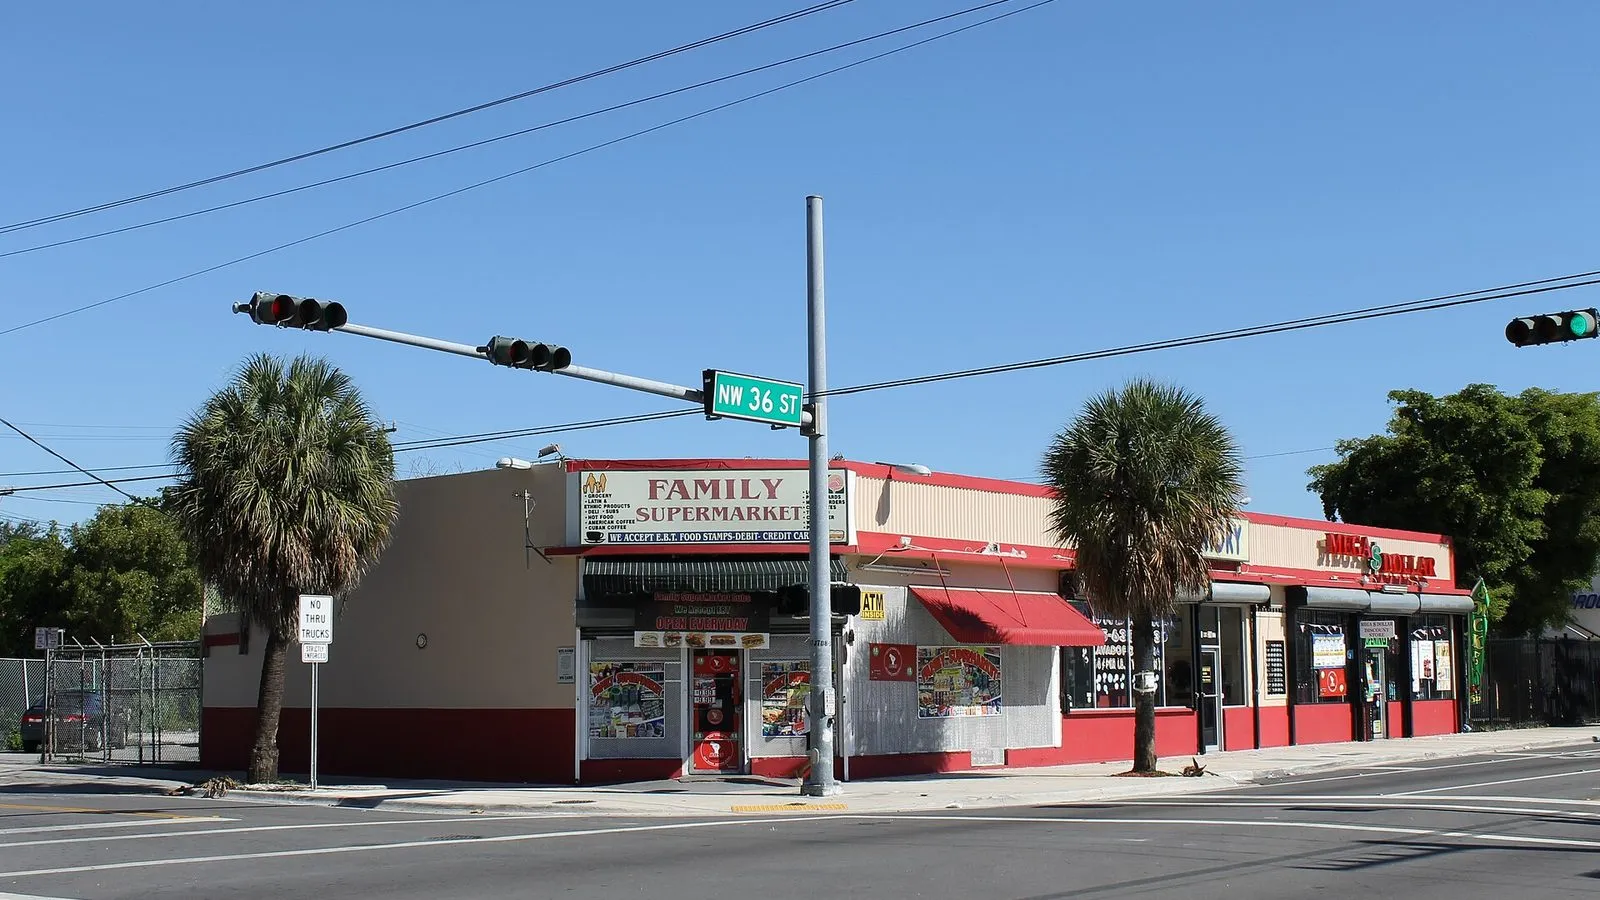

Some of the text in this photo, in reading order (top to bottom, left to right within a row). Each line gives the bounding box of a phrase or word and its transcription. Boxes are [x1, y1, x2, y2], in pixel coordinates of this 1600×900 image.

[718, 384, 798, 415] NW 36 ST
[648, 478, 783, 500] FAMILY
[635, 505, 802, 523] SUPERMARKET
[609, 533, 623, 542] WE
[624, 533, 655, 542] ACCEPT
[656, 533, 678, 542] E.B.T.
[679, 533, 702, 541] FOOD
[763, 531, 792, 540] CREDIT
[793, 531, 810, 540] CAR
[1325, 533, 1372, 558] MEGA
[1380, 553, 1437, 577] DOLLAR
[310, 600, 321, 609] NO
[862, 593, 884, 611] ATM
[305, 614, 326, 623] THRU
[656, 617, 749, 631] OPEN EVERYDAY
[301, 629, 330, 639] TRUCKS
